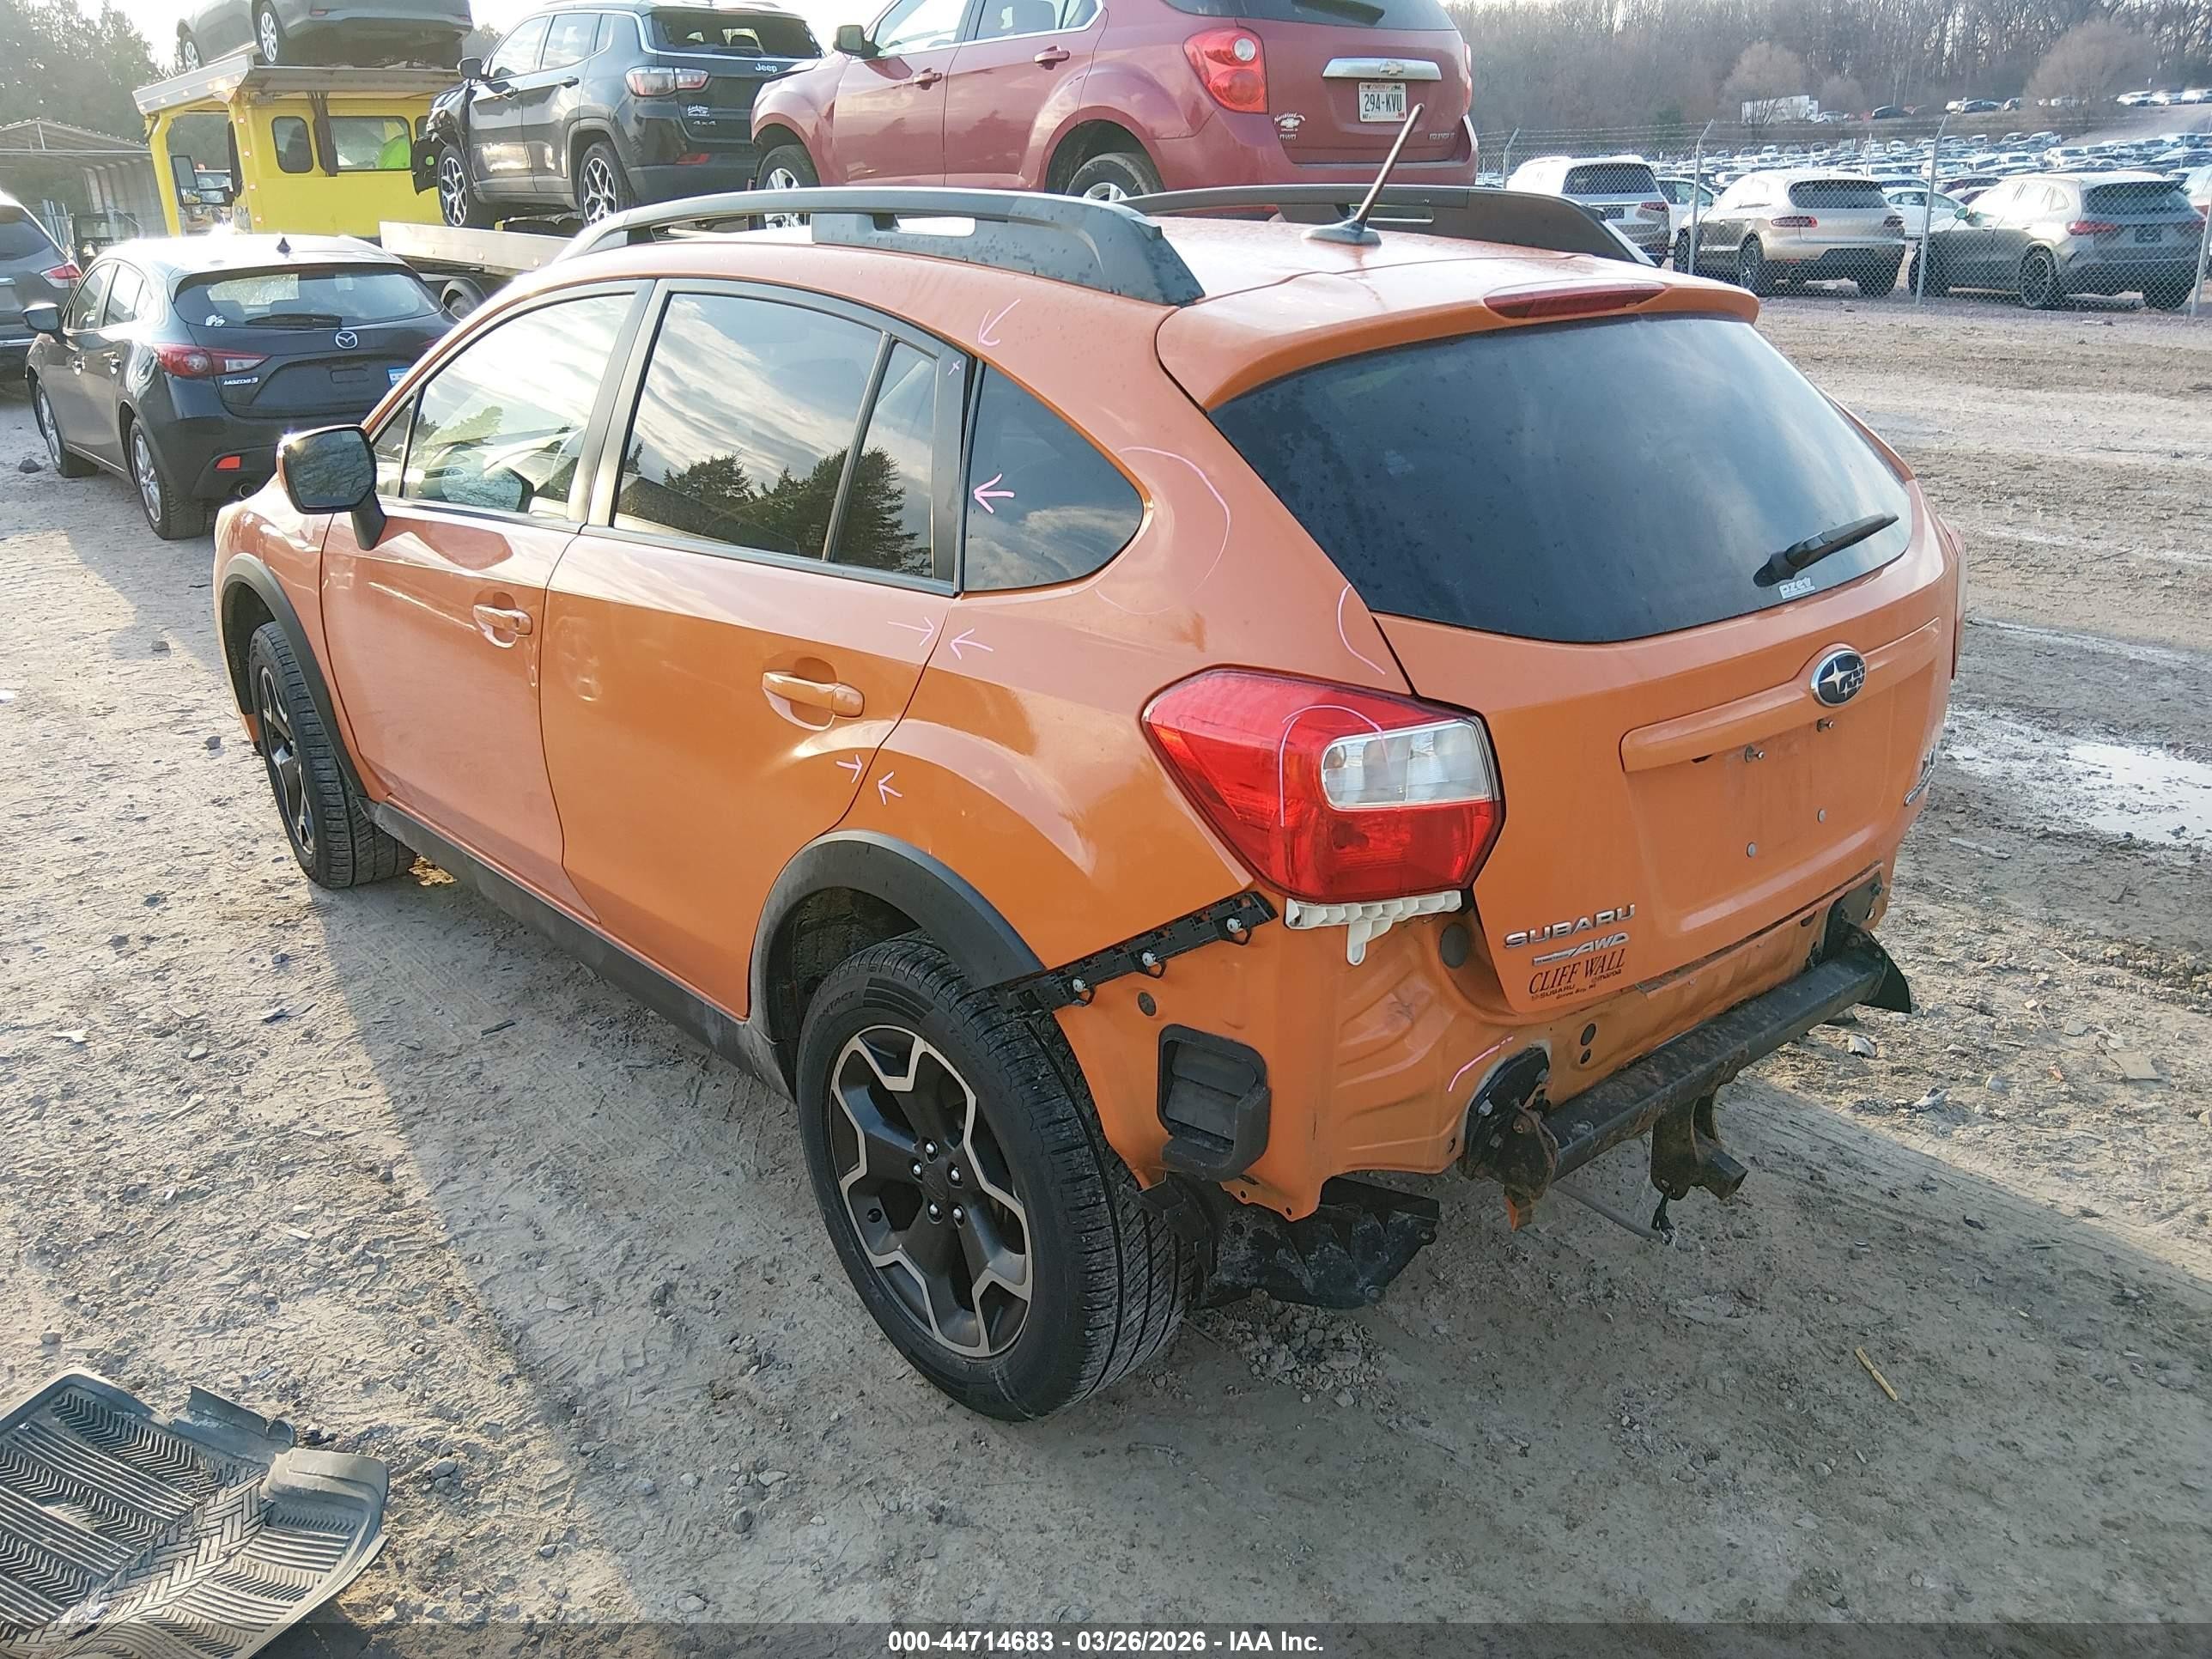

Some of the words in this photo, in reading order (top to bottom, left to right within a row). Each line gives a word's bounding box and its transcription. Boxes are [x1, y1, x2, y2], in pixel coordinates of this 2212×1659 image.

[756, 63, 777, 73] Jeep
[1364, 93, 1402, 112] 294-KVU
[1504, 903, 1635, 949] SUBARU
[1571, 932, 1630, 957] AWD
[1528, 962, 1582, 994] CLIFF
[1584, 948, 1626, 978] WALL
